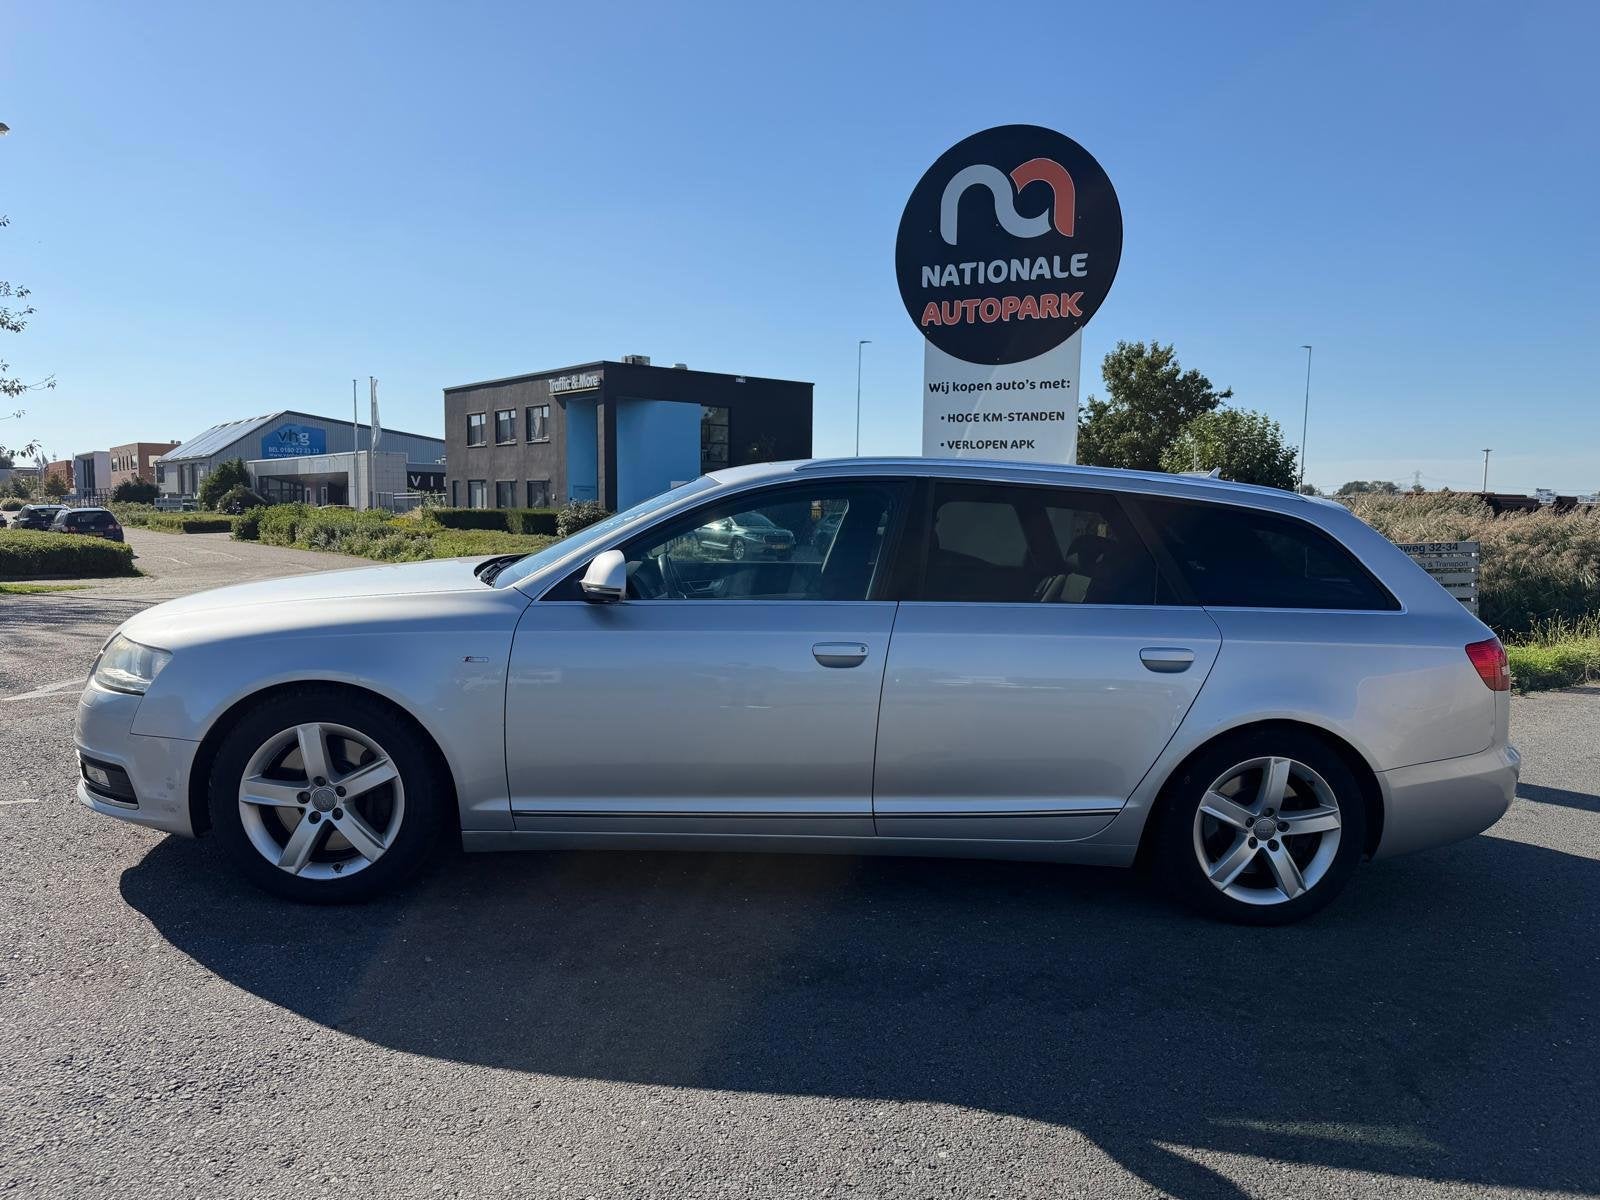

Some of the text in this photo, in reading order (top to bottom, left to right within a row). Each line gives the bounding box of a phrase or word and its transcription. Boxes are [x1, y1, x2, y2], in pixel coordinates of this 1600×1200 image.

[921, 253, 1089, 288] NATIONALE
[921, 291, 1085, 327] AUTOPARK
[549, 373, 599, 393] Traffic & More
[928, 378, 1071, 394] Wij kopen auto's met:
[947, 411, 1066, 423] HOGE KM-STANDEN
[277, 429, 310, 446] vhg
[947, 439, 1036, 450] VERLOPEN APK
[1428, 542, 1458, 552] 32-34
